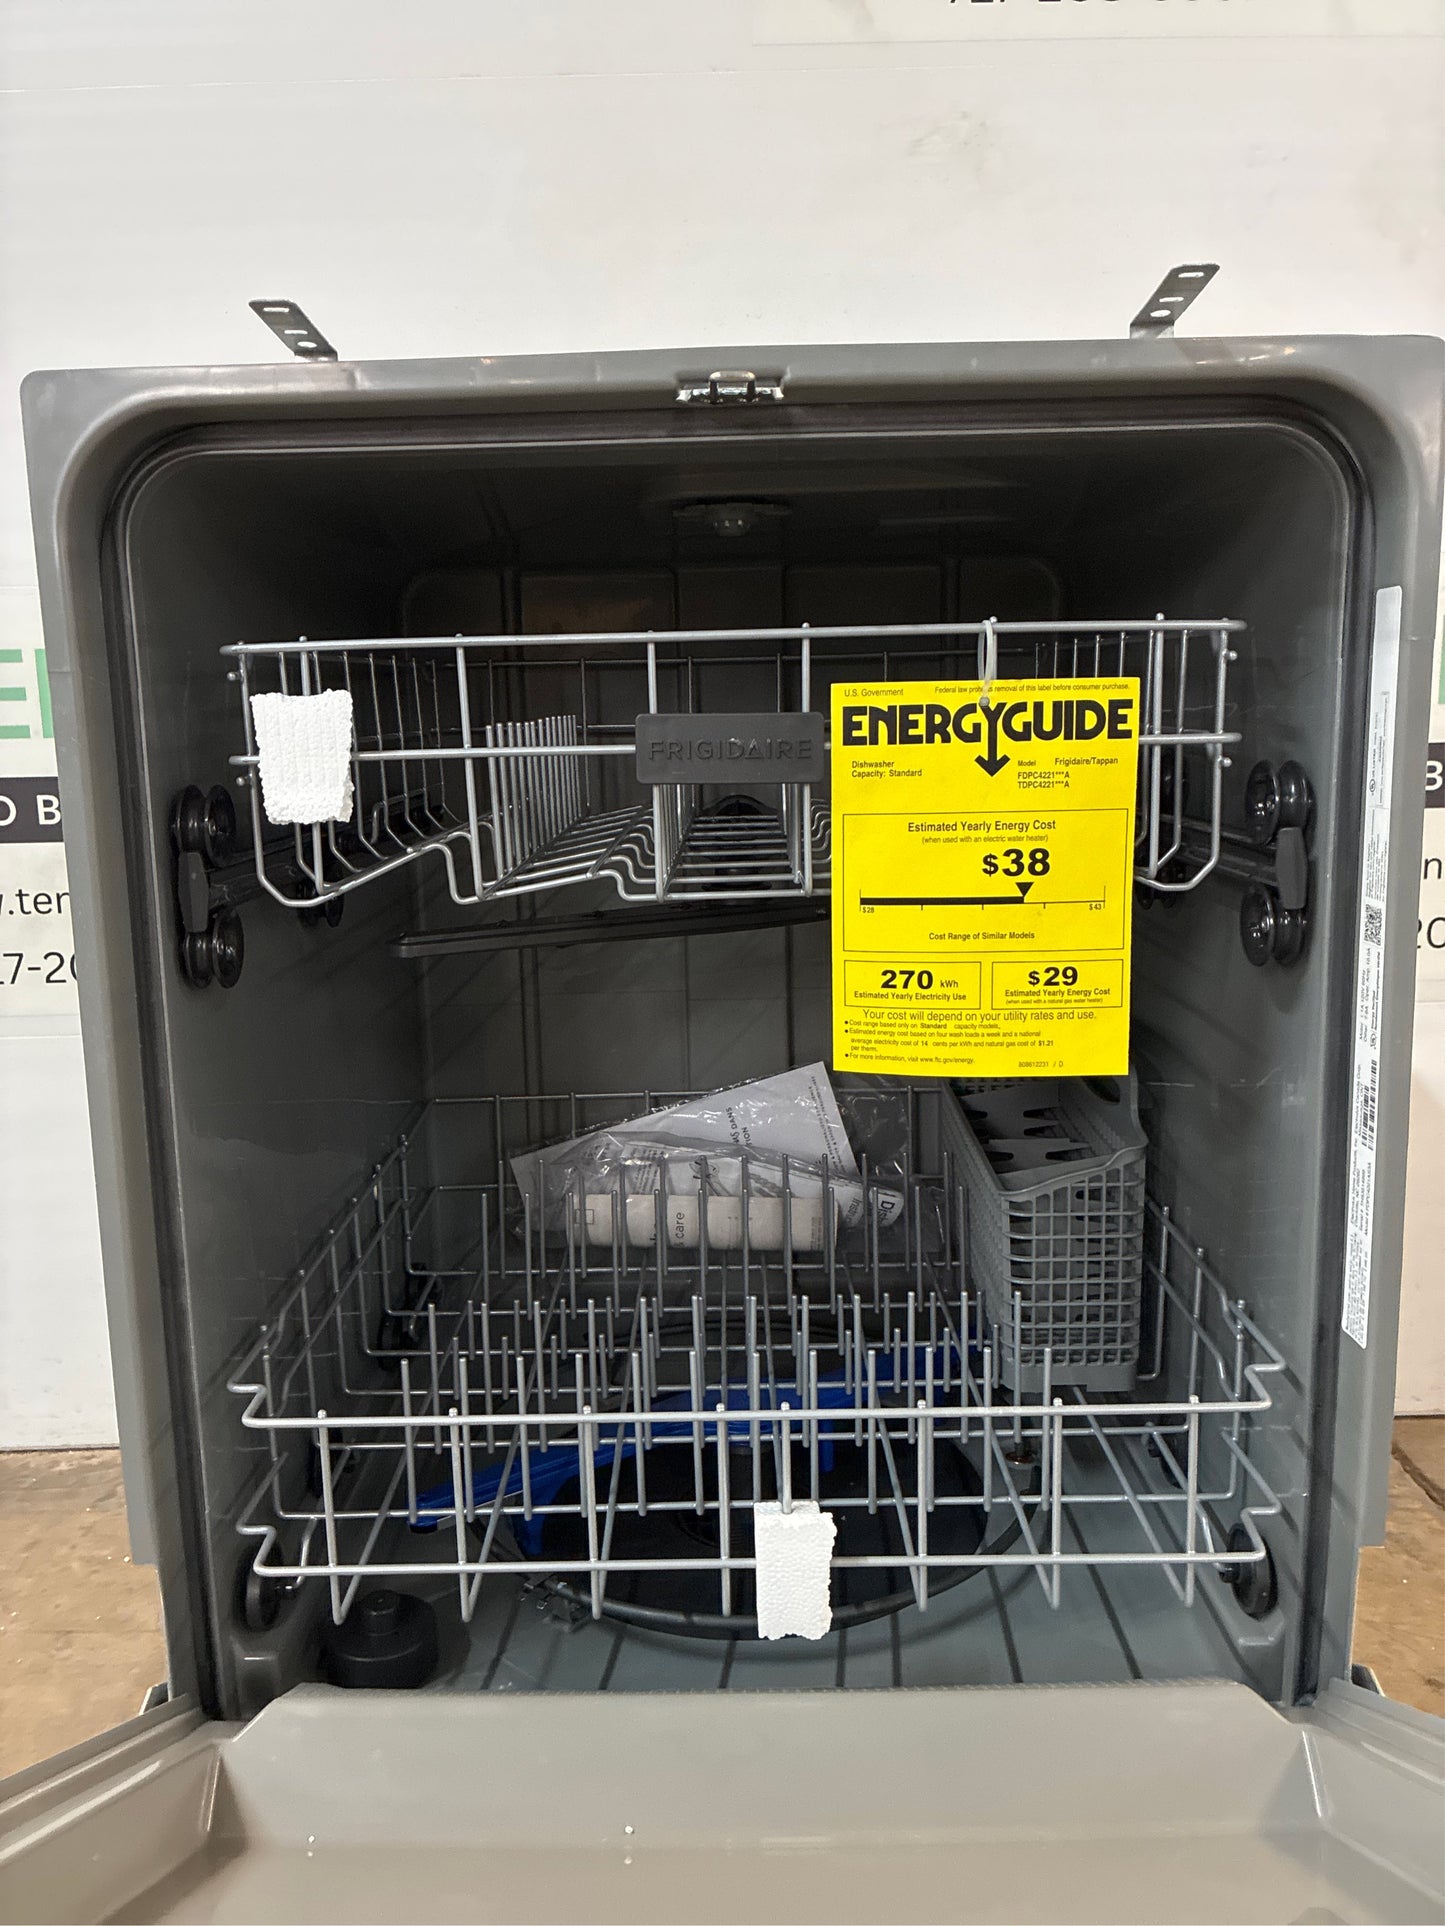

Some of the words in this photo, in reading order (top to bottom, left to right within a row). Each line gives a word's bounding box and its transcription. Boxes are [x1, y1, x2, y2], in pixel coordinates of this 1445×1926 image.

[844, 688, 859, 697] U.S.
[861, 688, 904, 697] Government
[1020, 684, 1025, 692] of
[843, 699, 1133, 746] ENERGYGUIDE
[649, 738, 812, 761] FRIGIDAIRE
[852, 760, 894, 768] Dishwasher
[1055, 757, 1118, 767] Frigidaire/Tappan
[852, 769, 886, 779] Capacity:
[889, 769, 922, 777] Standard
[908, 821, 957, 832] Estimated
[960, 821, 991, 833] Yearly
[995, 820, 1030, 832] Energy
[1033, 819, 1056, 830] Cost
[922, 837, 941, 845] (when
[983, 835, 1006, 843] electric
[1026, 834, 1048, 842] heater)
[0, 889, 70, 915] .te
[948, 932, 971, 941] Range
[973, 932, 980, 940] of
[982, 932, 1007, 940] Similar
[1009, 931, 1035, 939] Models
[0, 952, 77, 985] 7-2
[881, 970, 933, 989] 270
[940, 980, 958, 988] kWh
[854, 991, 889, 1000] Estimated
[891, 992, 912, 1001] Yearly
[915, 992, 951, 1002] Electricity
[1005, 989, 1040, 997] Estimated
[1043, 989, 1065, 997] Yearly
[1067, 988, 1092, 997] Energy
[863, 1009, 884, 1018] Your
[887, 1011, 906, 1020] cost
[910, 1011, 924, 1020] will
[927, 1011, 962, 1022] depend
[980, 1013, 1000, 1023] your
[1003, 1011, 1028, 1023] utility
[1031, 1012, 1054, 1020] rates
[1056, 1010, 1074, 1020] and
[1077, 1011, 1096, 1020] use.
[675, 1212, 685, 1239] care
